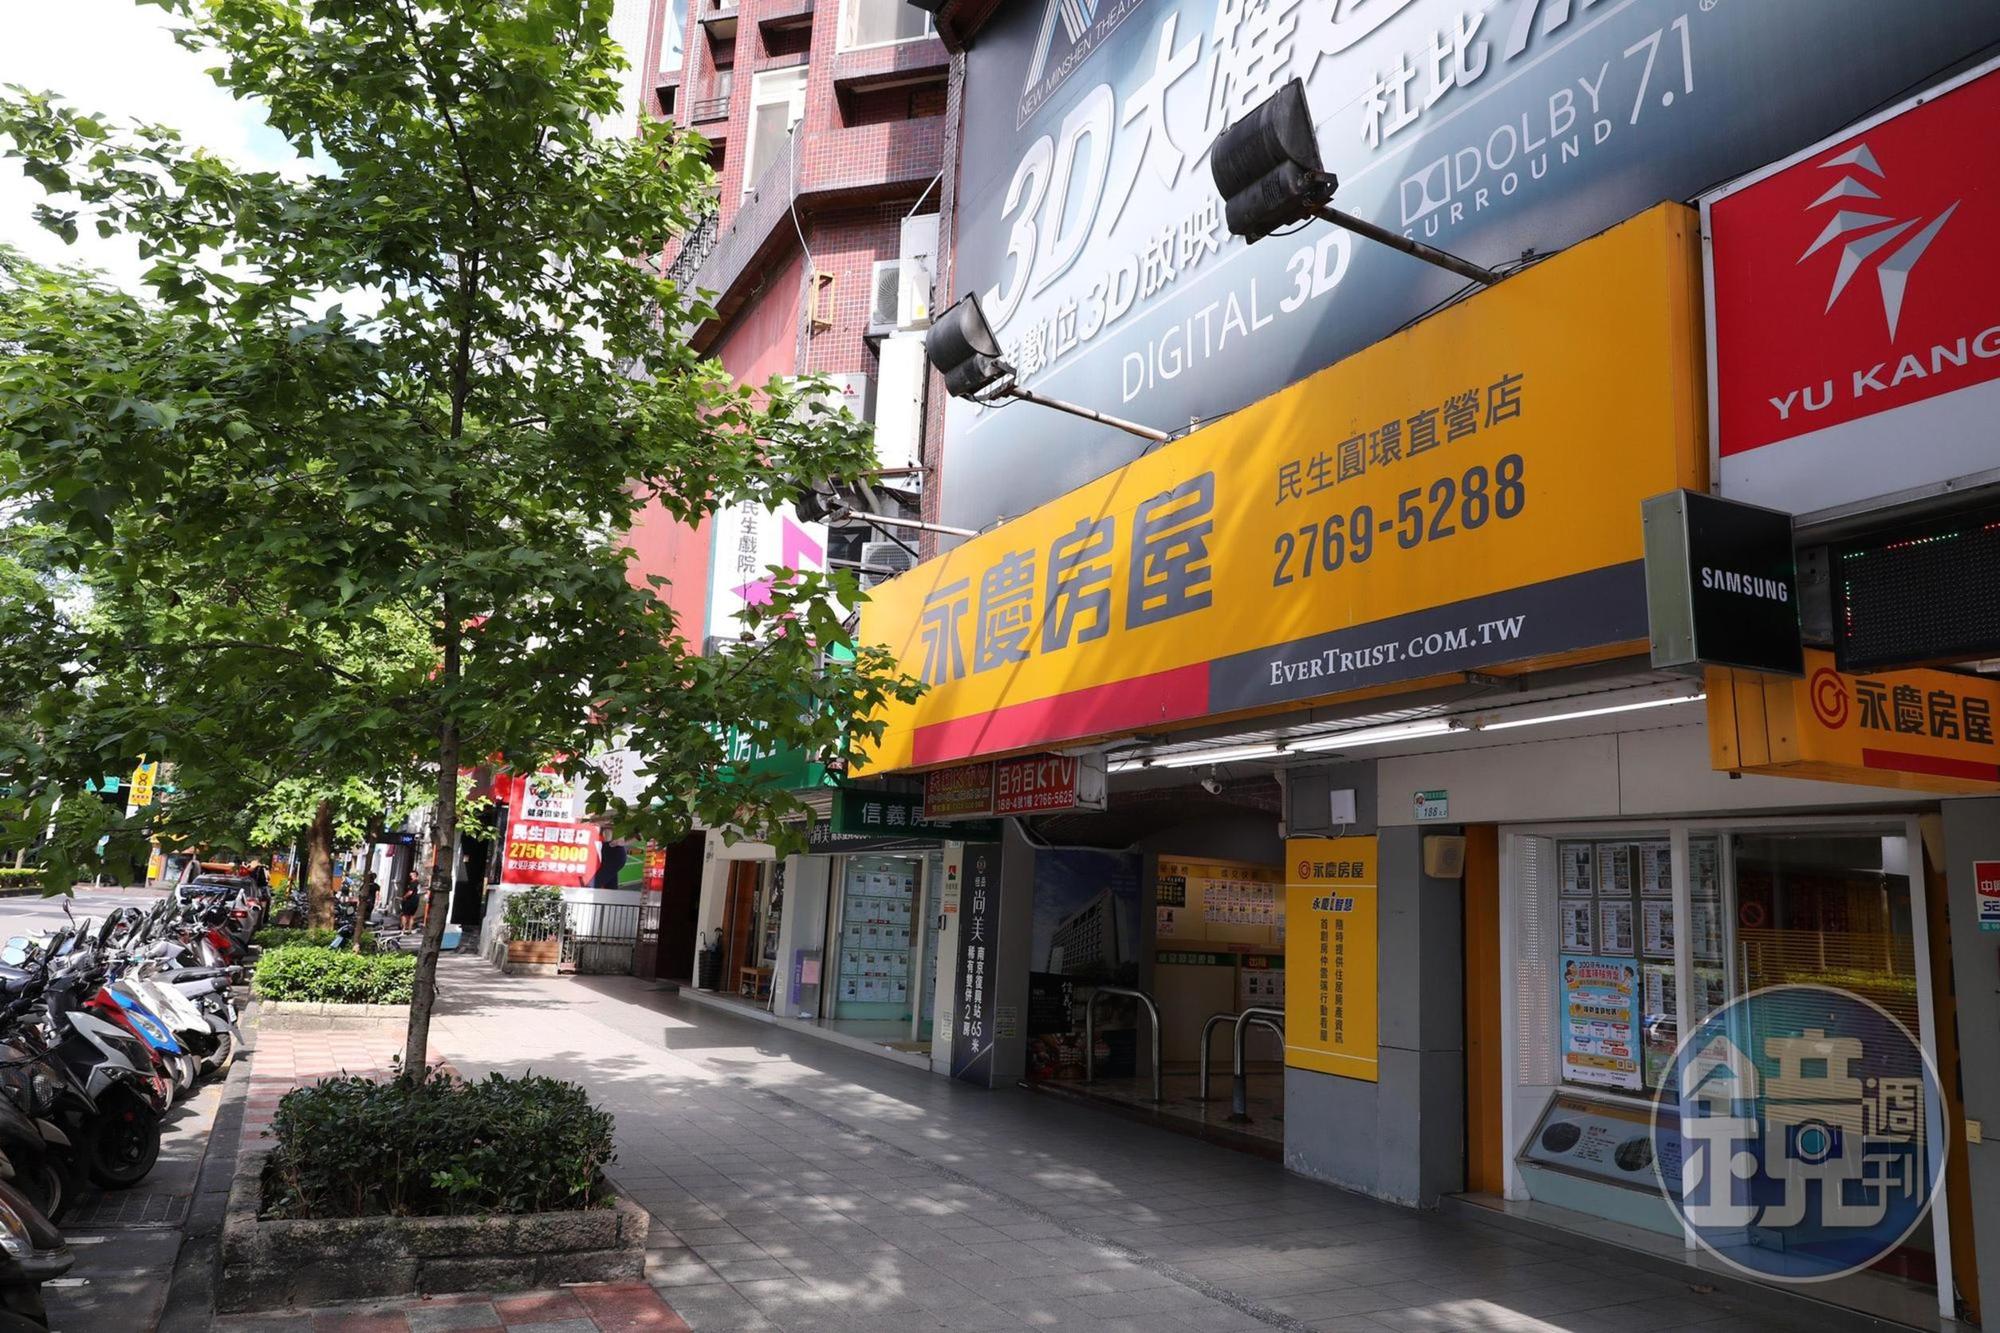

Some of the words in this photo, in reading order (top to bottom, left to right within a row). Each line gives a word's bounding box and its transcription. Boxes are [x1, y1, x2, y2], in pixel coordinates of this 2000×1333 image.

[1021, 83, 1044, 117] NEW
[1046, 33, 1093, 94] MINSHEN
[1456, 60, 1610, 187] DOLBY
[1624, 13, 1694, 126] 7.1
[1402, 118, 1613, 242] SURROUND
[1122, 277, 1274, 404] DIGITAL
[1279, 226, 1353, 314] 3D
[1768, 379, 1833, 421] YU
[1852, 325, 2000, 398] KANG
[1275, 372, 1525, 507] 民生圓環直營店
[1273, 453, 1526, 588] 2769-5288
[921, 470, 1215, 687] 永慶房屋
[1702, 566, 1788, 603] SAMSUNG
[1855, 679, 1994, 746] 永慶房屋
[535, 799, 562, 809] GYM
[999, 759, 1073, 795] 百分百KTV
[509, 842, 589, 862] 2756-3000
[1313, 861, 1364, 879] 永慶房屋
